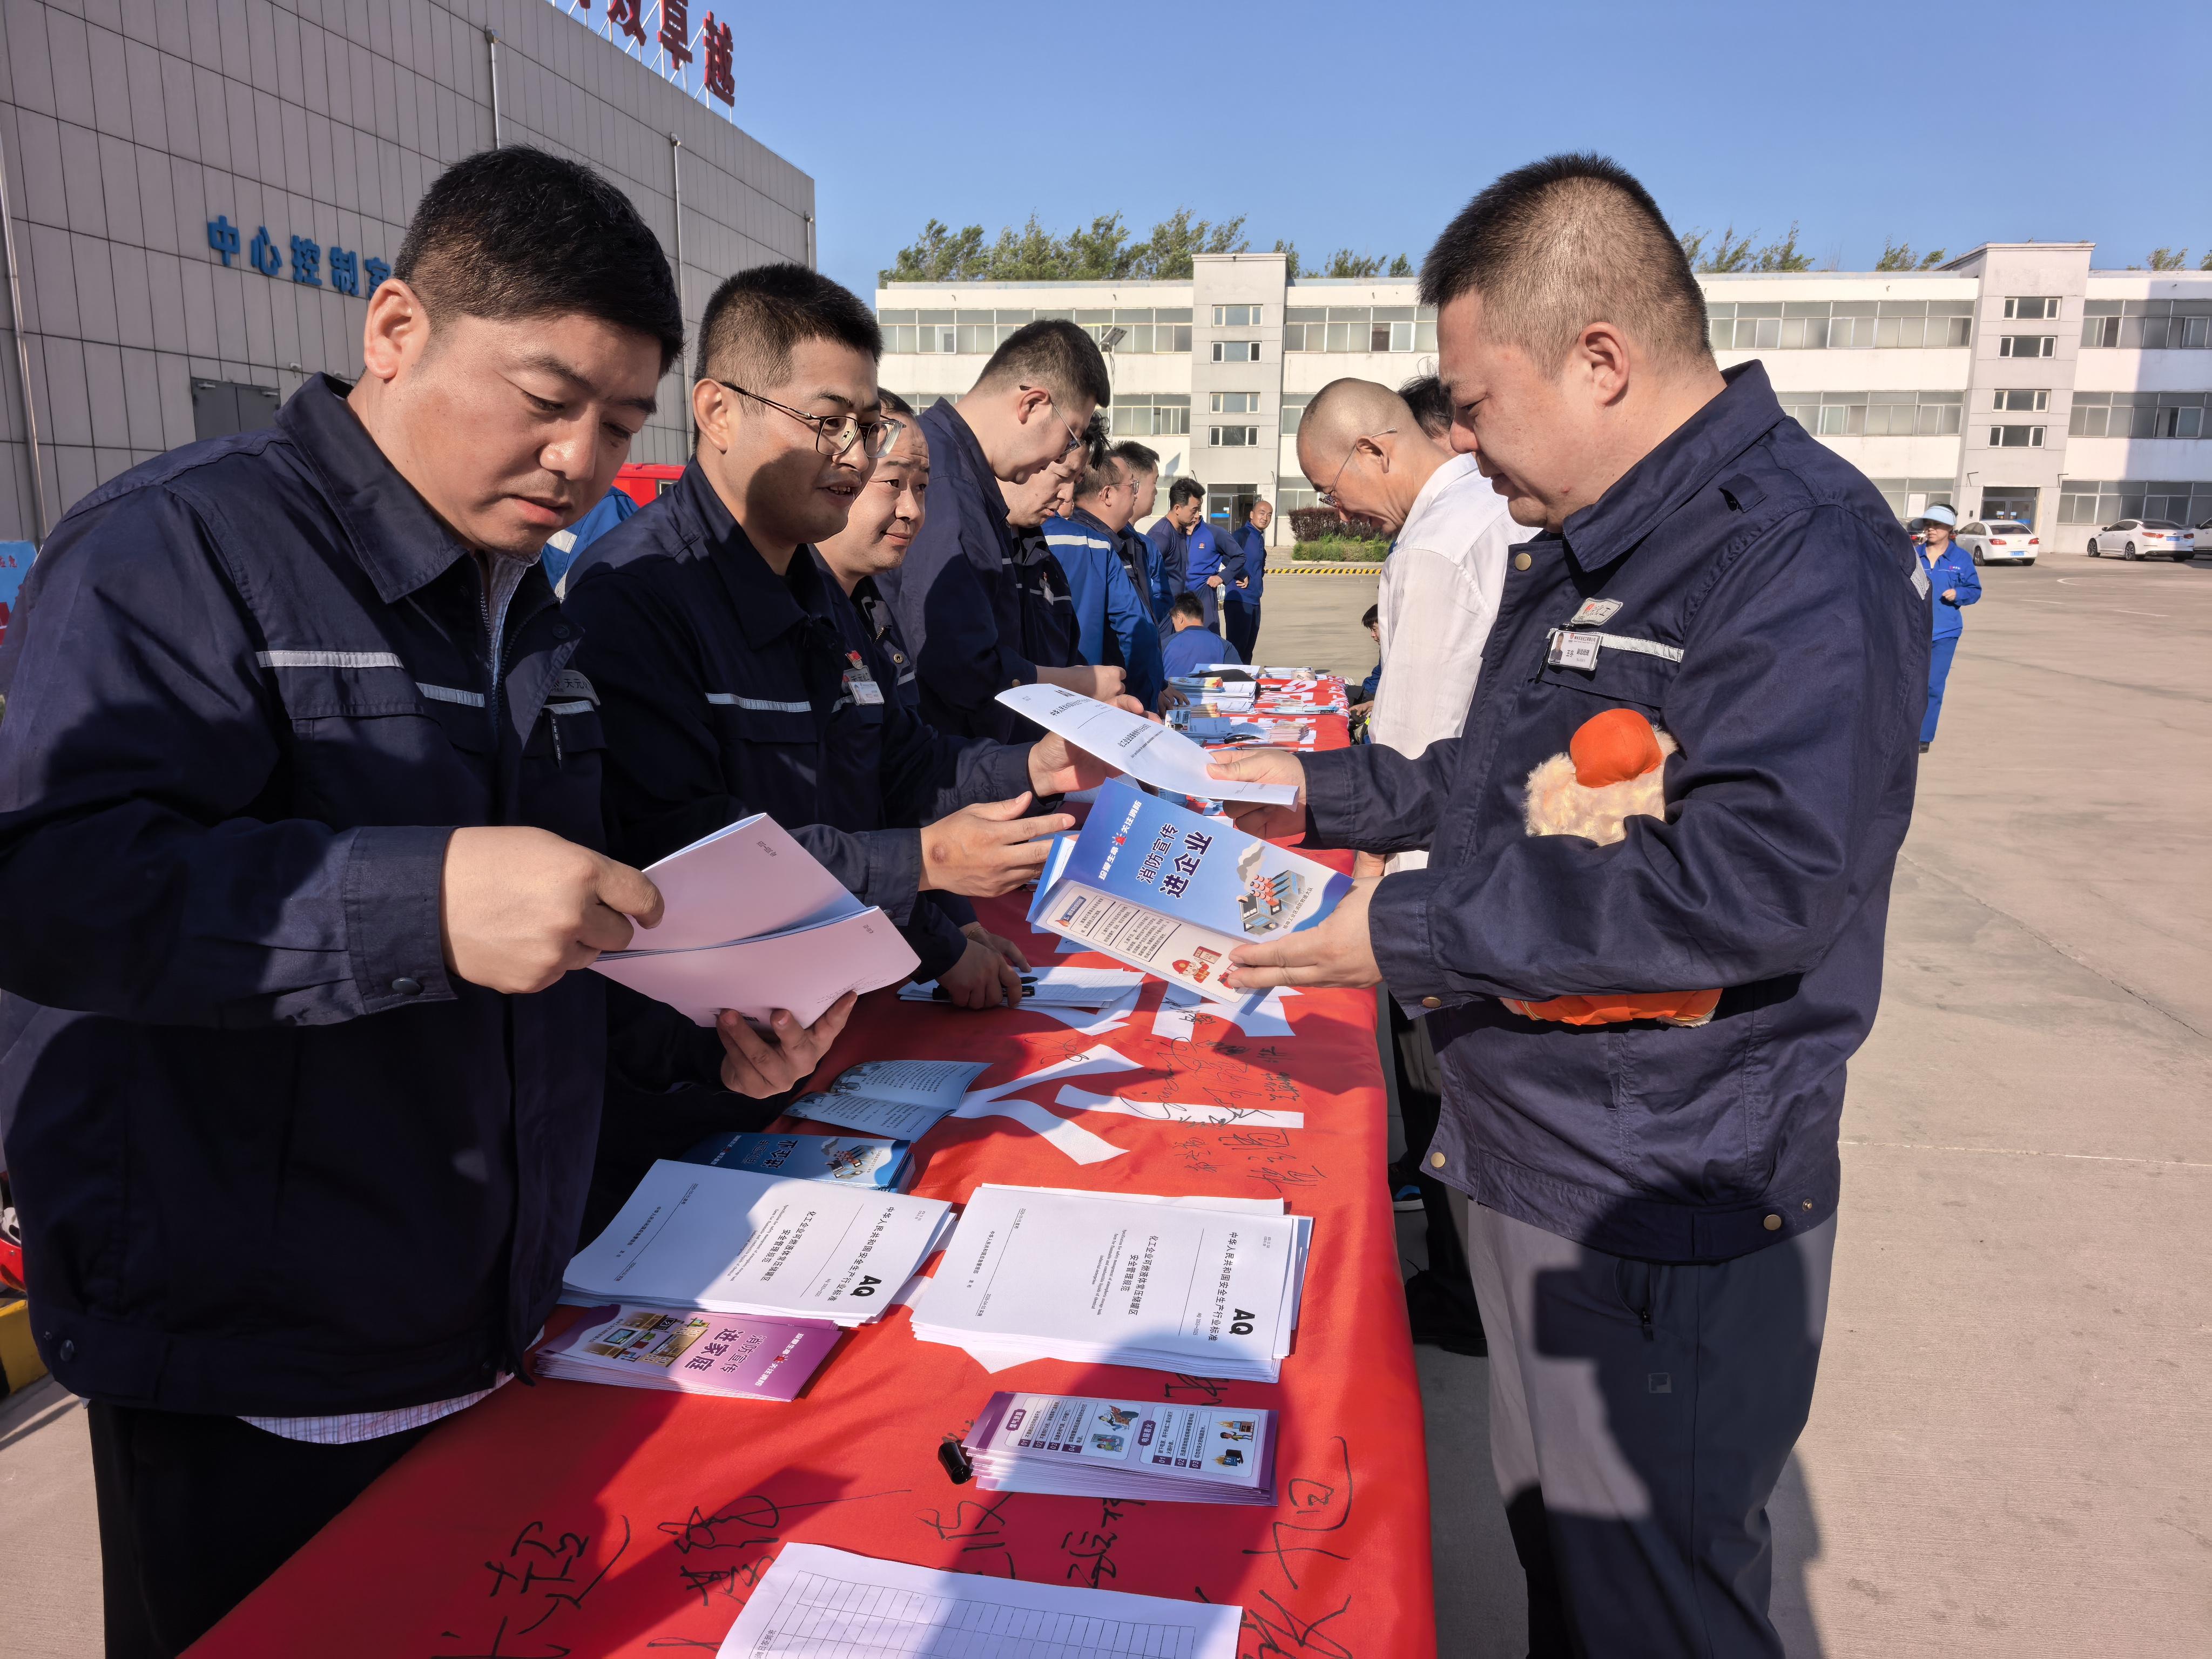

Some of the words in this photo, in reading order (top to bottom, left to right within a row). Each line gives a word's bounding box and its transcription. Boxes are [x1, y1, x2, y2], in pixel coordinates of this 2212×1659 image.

[1098, 846, 1120, 881] 珍爱生命
[1120, 799, 1143, 834] 关注消防
[1135, 822, 1180, 885] 消防宣传
[1159, 830, 1214, 899] 进企业
[759, 1139, 799, 1169] 进企业
[759, 1210, 818, 1283] 化工企业可燃液体常压储罐区
[760, 1228, 792, 1264] 安全管理规范
[825, 1206, 896, 1303] 中华人民共和国安全生产行业标准
[971, 1230, 996, 1274] 中华人民共和国应急管理部
[848, 1273, 884, 1300] AQ
[1118, 1254, 1140, 1292] 安全管理规范
[1126, 1235, 1159, 1316] 化工企业可燃液体常压储罐区
[1205, 1231, 1239, 1342] 中华人民共和国安全生产行业标准
[1228, 1307, 1257, 1337] AQ
[681, 1327, 745, 1373] 进家庭
[716, 1334, 768, 1374] 消防宣传
[779, 1332, 804, 1355] 珍爱生命
[752, 1362, 779, 1387] 关注消防
[1140, 1423, 1154, 1442] 电脑着火
[1190, 1460, 1199, 1468] 03
